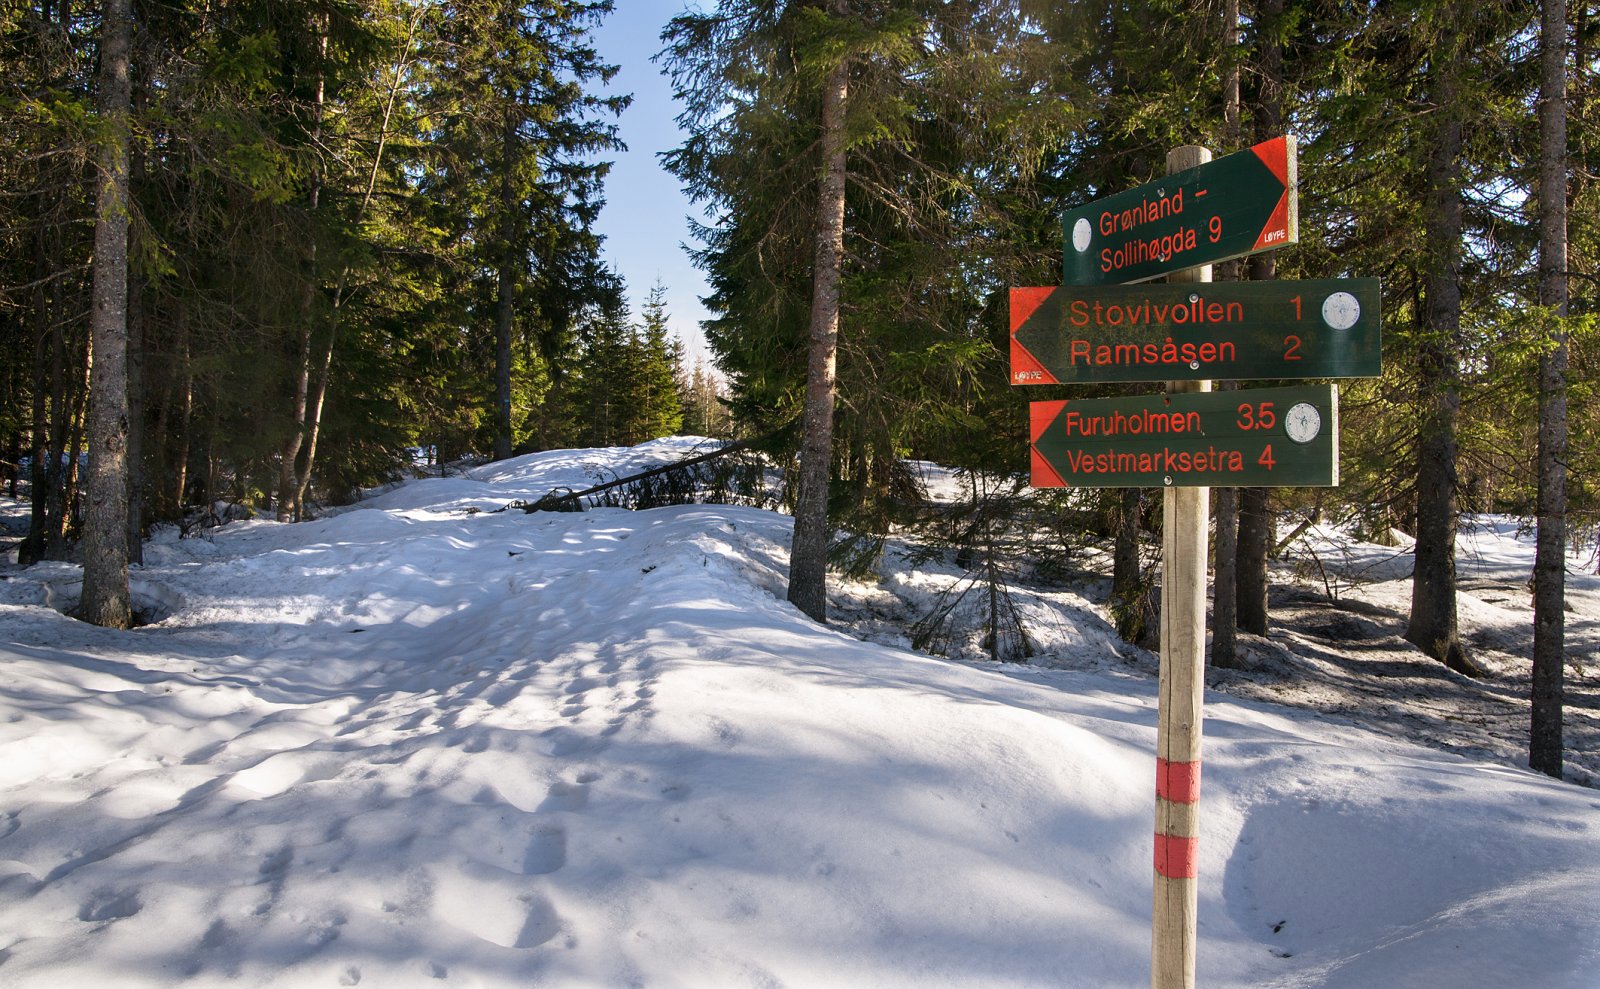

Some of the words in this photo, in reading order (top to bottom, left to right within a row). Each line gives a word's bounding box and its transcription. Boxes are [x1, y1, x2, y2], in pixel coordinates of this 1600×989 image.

[1099, 187, 1183, 237] Grønland
[1100, 227, 1197, 272] Sollihøgda
[1208, 216, 1222, 243] 9
[1264, 229, 1286, 243] LØYPE
[1069, 297, 1243, 327] Stovivollen
[1290, 296, 1301, 321] 1
[1070, 336, 1236, 366] Ramsåsen
[1283, 335, 1302, 361] 2
[1066, 409, 1201, 436] Furuholmen
[1067, 445, 1243, 474] Vestmarksetra
[1258, 444, 1277, 471] 4
